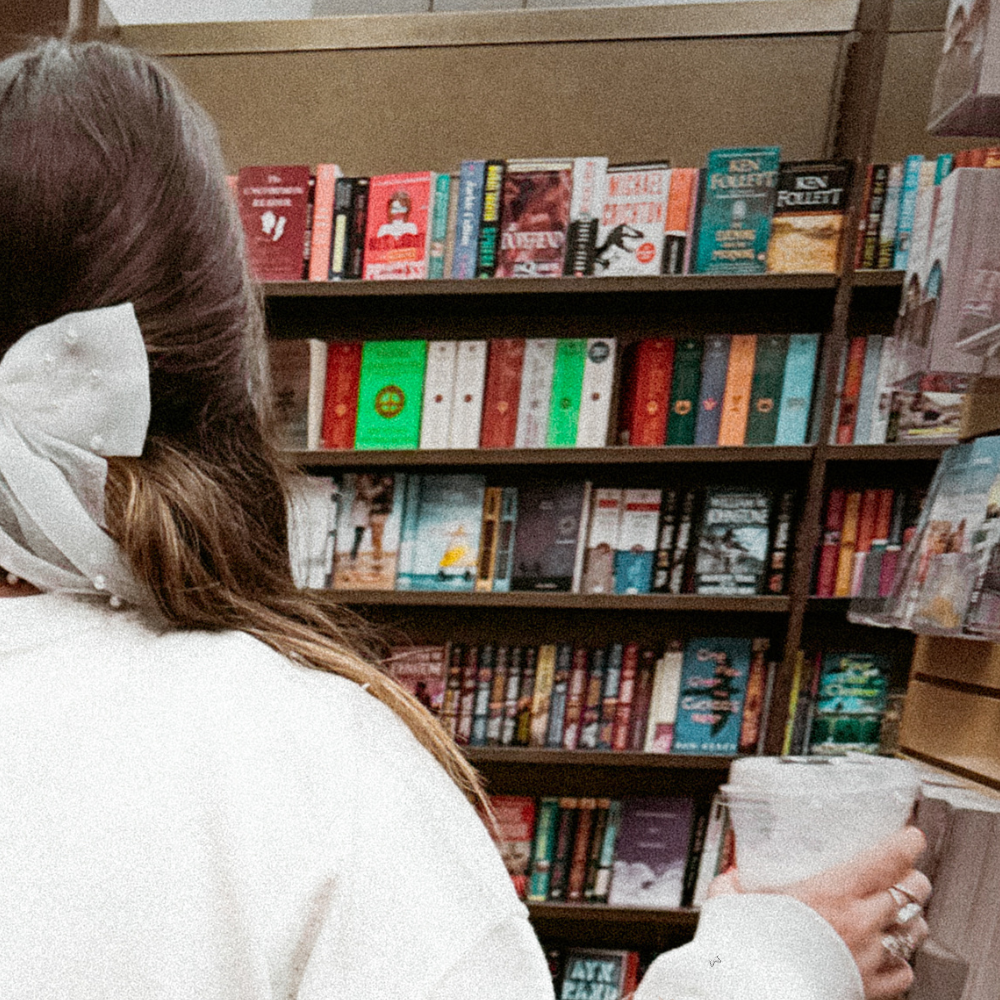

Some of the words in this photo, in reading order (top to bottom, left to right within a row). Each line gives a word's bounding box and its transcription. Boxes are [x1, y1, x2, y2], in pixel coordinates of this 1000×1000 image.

[729, 158, 760, 173] KEN
[710, 170, 778, 190] FOLLETT
[795, 175, 829, 190] KEN
[776, 188, 844, 208] FOLLETT
